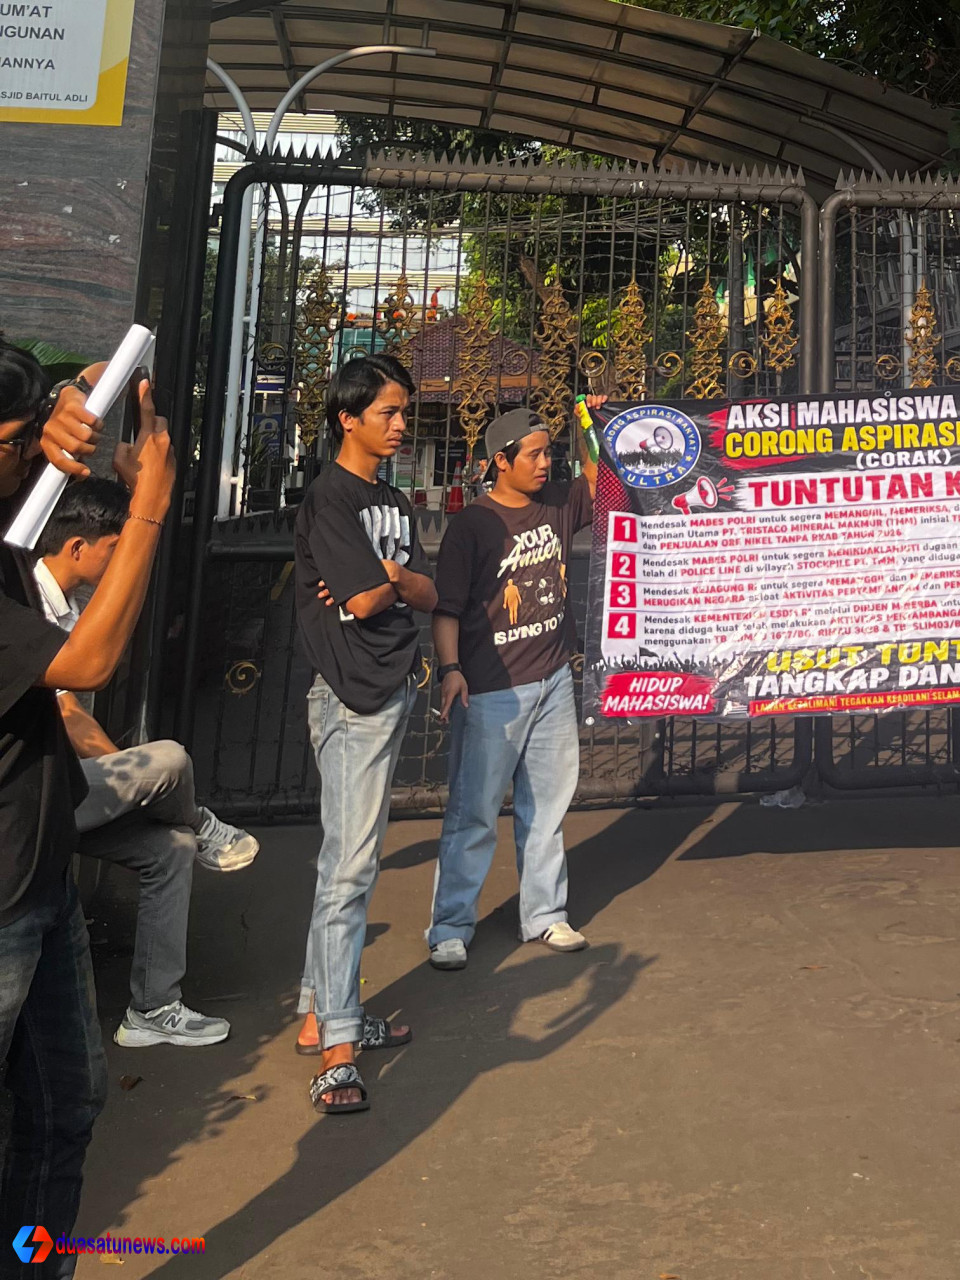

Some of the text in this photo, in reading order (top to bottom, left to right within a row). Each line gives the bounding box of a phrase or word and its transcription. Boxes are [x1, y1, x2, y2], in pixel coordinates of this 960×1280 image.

[0, 57, 55, 70] ANNYA
[0, 91, 88, 103] SJID BAITUL ADLI
[727, 403, 789, 430] AKSI
[797, 395, 958, 427] MAHASISWA
[626, 409, 677, 421] ASPIRASI
[676, 418, 697, 451] RAKYAT
[725, 428, 833, 458] CORONG
[856, 448, 952, 470] (CORAK)
[748, 472, 933, 507] TUNTUTAN
[513, 524, 553, 550] YOUR
[622, 520, 631, 539] 1
[640, 519, 687, 529] Mendesak
[690, 517, 724, 527] MABES
[727, 515, 756, 525] POLRI
[758, 514, 787, 523] untuk
[789, 512, 821, 523] segera
[641, 530, 685, 542] Pimpinan
[687, 528, 719, 537] Utama
[790, 521, 835, 532] MINERAL
[838, 519, 883, 529] MAKMUR
[920, 515, 949, 524] inisial
[643, 541, 657, 549] dan
[660, 539, 718, 549] PENJUALAN
[744, 536, 773, 546] NIKEL
[776, 534, 809, 544] TANPA
[618, 555, 631, 576] 2
[642, 556, 689, 566] Mendesak
[692, 554, 727, 564] MABES
[730, 553, 759, 562] POLRI
[761, 551, 790, 560] untuk
[792, 549, 825, 561] segera
[922, 541, 958, 553] dugaan
[642, 568, 665, 577] telah
[668, 568, 677, 576] di
[680, 566, 715, 575] POLICE
[718, 565, 741, 573] LINE
[744, 564, 753, 572] di
[796, 559, 851, 569] STOCKPILE
[901, 555, 926, 565] yang
[617, 585, 631, 605] 3
[643, 586, 689, 596] Mendesak
[760, 580, 789, 590] untuk
[791, 578, 823, 590] segera
[643, 596, 701, 607] MERUGIKAN
[922, 581, 941, 590] dan
[494, 631, 507, 645] IS
[508, 622, 542, 642] LYING
[543, 616, 557, 632] TO
[614, 615, 630, 636] 4
[644, 614, 691, 624] Mendesak
[644, 626, 675, 635] karena
[678, 624, 713, 635] diduga
[716, 622, 739, 631] kuat
[771, 617, 826, 628] melakukan
[644, 634, 710, 647] menggunakan
[714, 633, 726, 642] TB
[882, 624, 890, 632] &
[767, 646, 864, 672] USUT
[629, 677, 683, 693] HIDUP
[743, 667, 889, 697] TANGKAP
[604, 694, 710, 712] MAHASISWA!
[840, 695, 884, 707] TEGAKKAN
